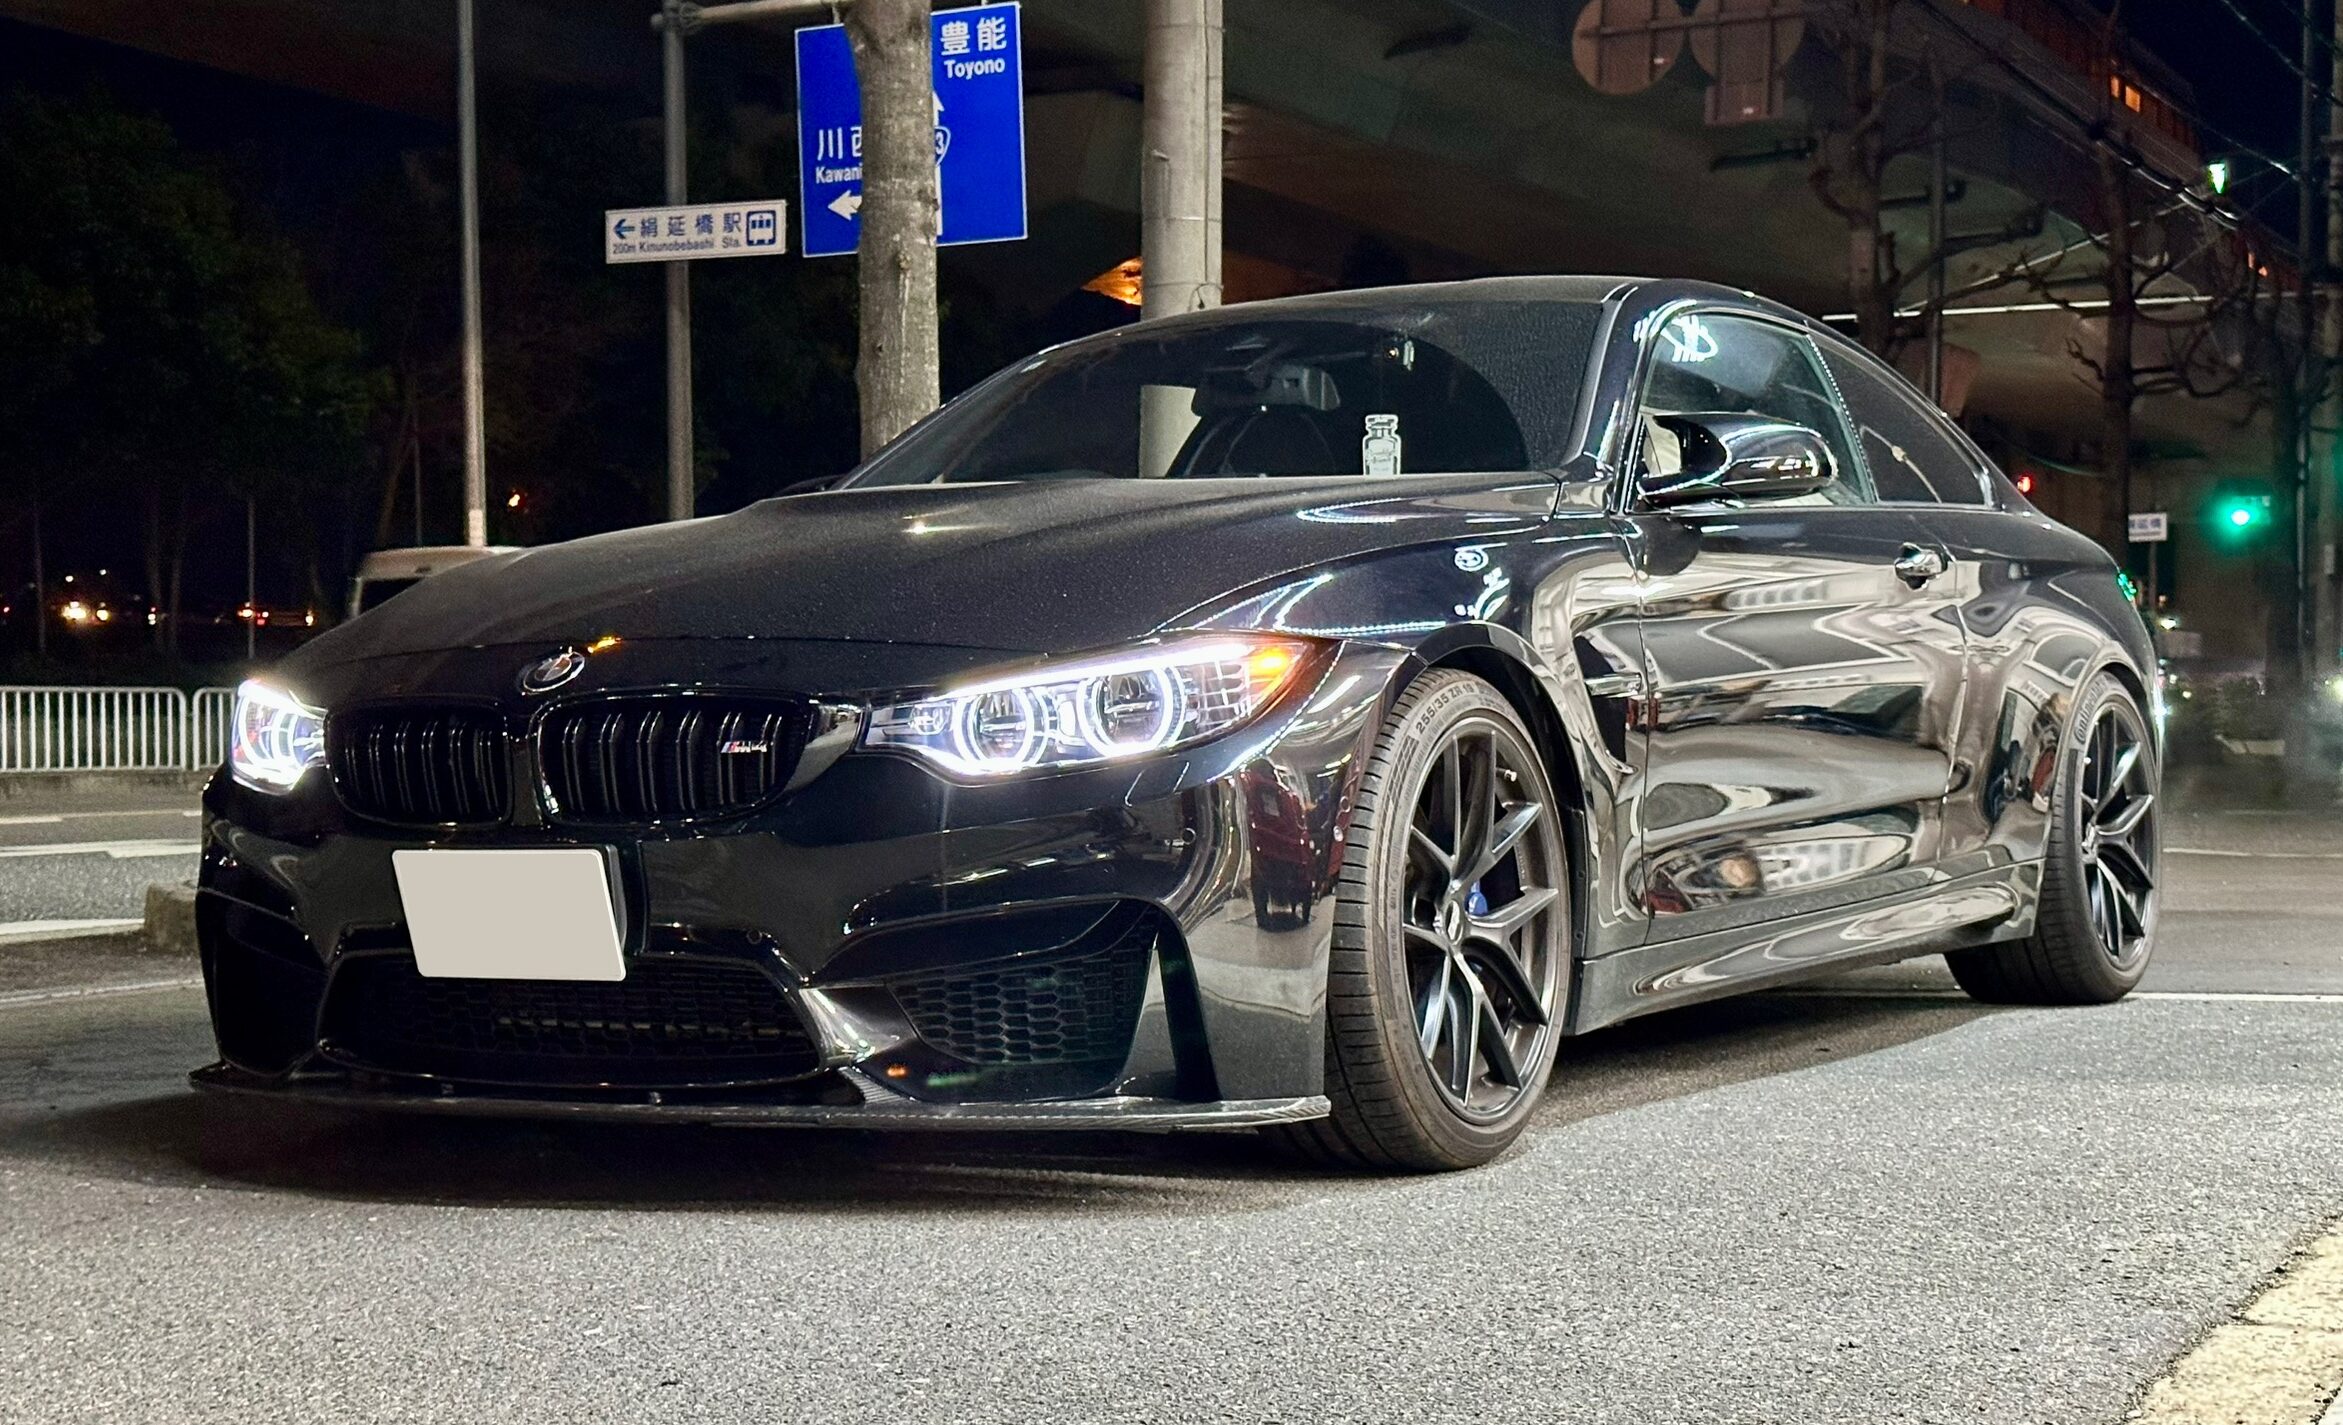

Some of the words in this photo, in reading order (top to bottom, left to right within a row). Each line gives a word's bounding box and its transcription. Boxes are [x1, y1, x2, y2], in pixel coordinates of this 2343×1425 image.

[940, 16, 1007, 56] 豊能
[943, 57, 1006, 80] Toyono
[815, 162, 863, 184] Kawani
[613, 243, 636, 255] 200m
[722, 236, 742, 249] Sta.
[1415, 693, 1450, 735] 255/35
[1448, 684, 1463, 699] ZR
